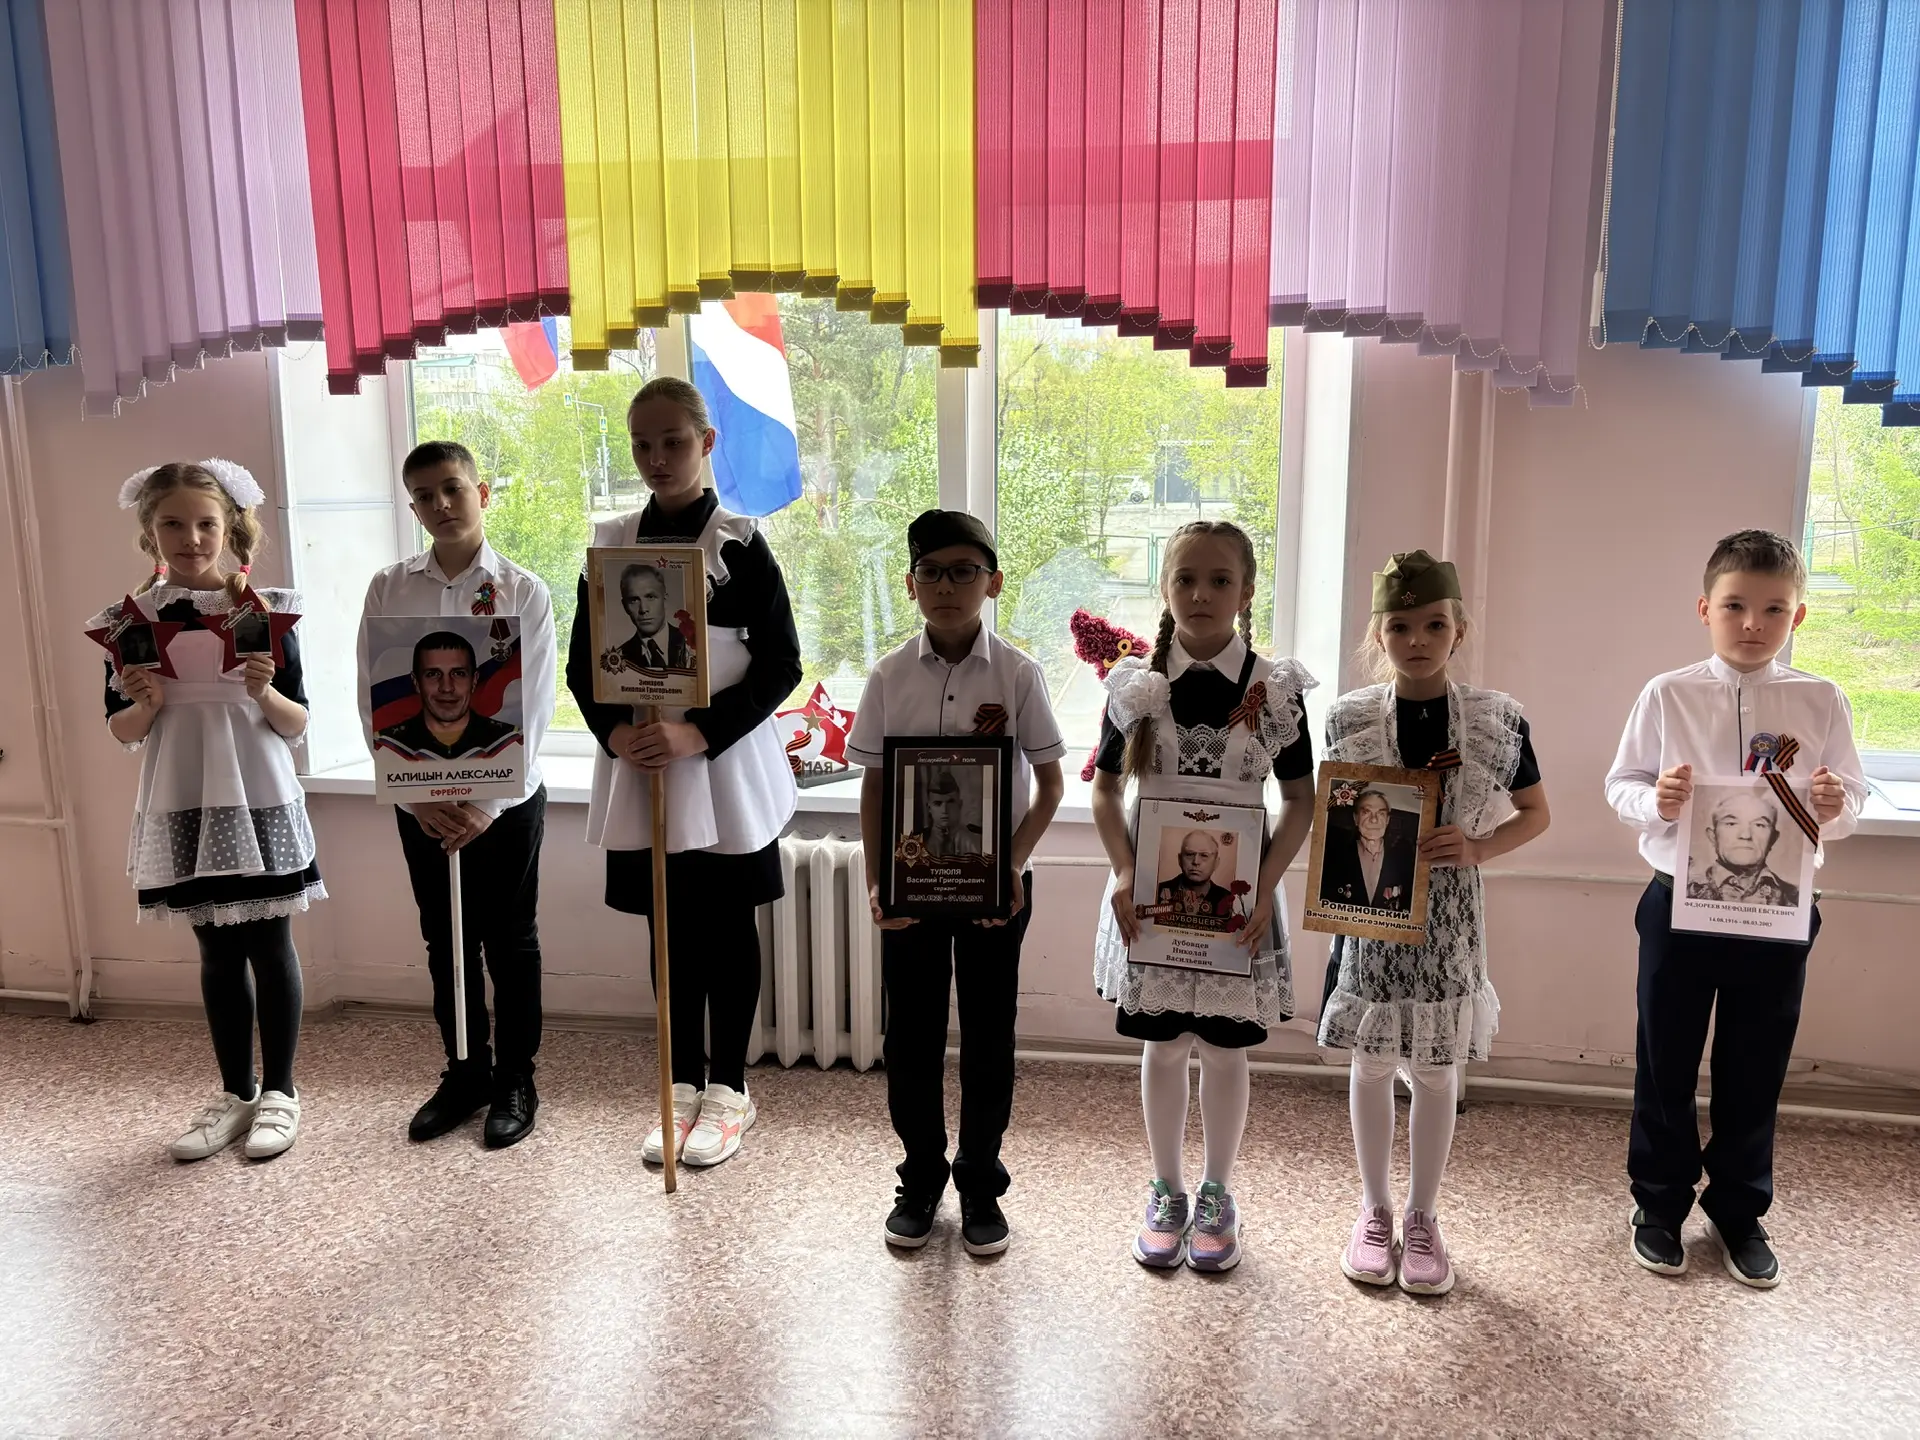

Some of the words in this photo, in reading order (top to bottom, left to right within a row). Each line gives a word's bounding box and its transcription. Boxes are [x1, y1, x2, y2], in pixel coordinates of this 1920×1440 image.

[802, 762, 832, 773] МАЯ
[387, 772, 442, 782] КАПИЦЫН
[446, 769, 513, 779] АЛЕКСАНДР
[431, 787, 472, 796] ЕФРЕЙТОР
[1321, 900, 1409, 920] Романовский
[1721, 904, 1757, 913] МЕФОДИЙ
[1168, 915, 1216, 926] ДУБОВЦЕВ
[1306, 910, 1349, 922] Вячеслав
[1172, 939, 1209, 949] Дубовцев
[1172, 947, 1207, 957] Николай
[1166, 955, 1213, 966] Васильевич
